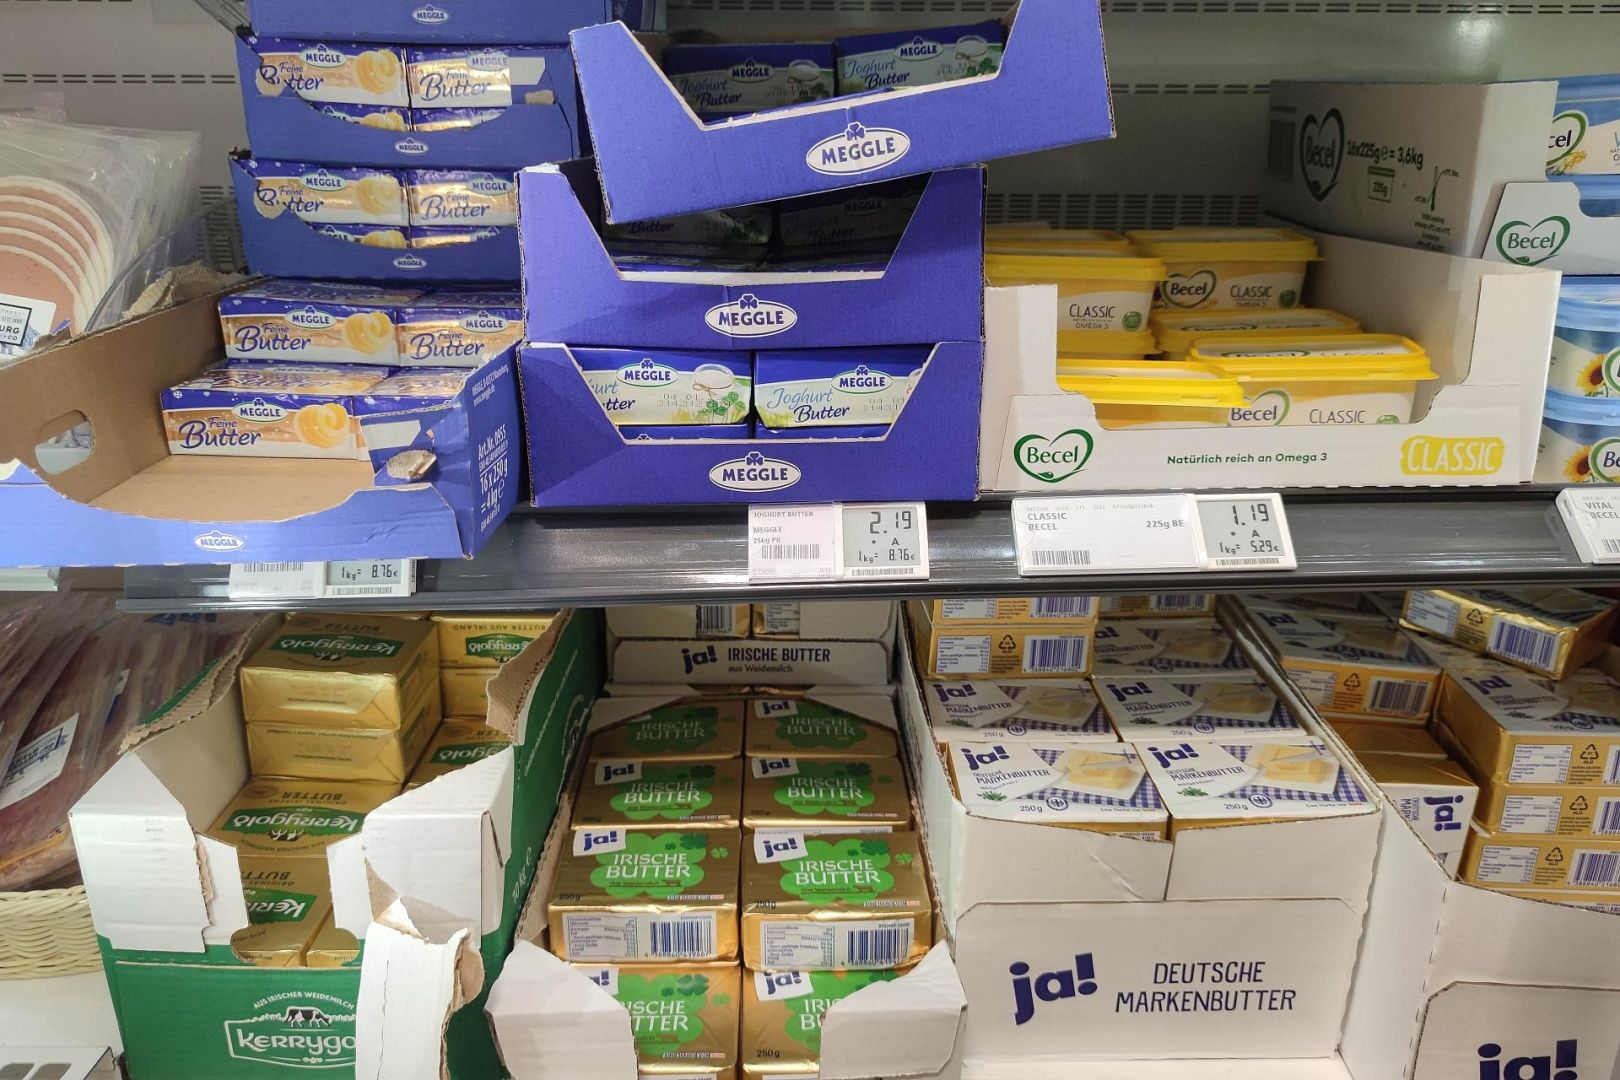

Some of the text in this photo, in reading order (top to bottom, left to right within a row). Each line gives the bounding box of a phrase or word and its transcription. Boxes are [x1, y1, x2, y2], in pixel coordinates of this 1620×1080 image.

[415, 10, 446, 20] MEGGLE
[305, 53, 341, 63] MEGGLE
[900, 45, 937, 56] MEGGLE
[279, 61, 303, 73] Feine
[471, 56, 508, 66] MEGGLE
[843, 57, 896, 79] Joghurt
[732, 68, 770, 78] MEGGLE
[864, 71, 911, 88] Butter
[419, 72, 491, 101] Butter
[697, 93, 742, 108] Butter
[821, 136, 896, 165] MEGGLE
[306, 177, 341, 187] MEGGLE
[472, 182, 508, 191] MEGGLE
[279, 185, 303, 196] Feine
[256, 187, 324, 213] Btter
[420, 194, 490, 220] Butter
[1507, 231, 1555, 249] Becel
[1170, 281, 1207, 296] Becel
[1230, 285, 1273, 297] CLASSIC
[1069, 303, 1115, 318] CLASSIC
[292, 314, 330, 324] MEGGLE
[465, 319, 504, 328] MEGGLE
[717, 310, 785, 327] MEGGLE
[262, 322, 289, 334] Feine
[235, 325, 311, 352] Butter
[410, 333, 485, 360] Butter
[624, 370, 671, 381] MEGGLE
[839, 376, 886, 388] MEGGLE
[766, 387, 833, 411] Joghurt
[240, 407, 281, 417] MEGGLE
[793, 404, 850, 423] Butter
[1231, 405, 1277, 421] Becel
[1310, 408, 1366, 424] CLASSIC
[208, 416, 238, 429] Feine
[178, 420, 262, 449] Butter
[1026, 444, 1079, 465] Becel
[1167, 452, 1328, 464] Natürlich reich an Omega 3
[1407, 440, 1498, 474] CLASSIC
[722, 467, 788, 482] MEGGLE
[870, 510, 911, 534] 2.19
[1027, 512, 1068, 521] CLASSIC
[1232, 504, 1269, 525] 1.19
[1028, 519, 1184, 531] BECEL 225g BE
[1252, 529, 1260, 537] A
[200, 538, 239, 547] MEGGLE
[892, 537, 900, 546] A
[681, 645, 830, 674] ja! IRISCHE BUTTER
[728, 663, 793, 673] aus Weidemilch
[1106, 682, 1152, 702] ja!
[1462, 674, 1512, 695] ja!
[932, 683, 976, 702] ja!
[762, 700, 790, 715] ja!
[945, 702, 1012, 713] MARKENBUTTER
[1125, 700, 1193, 713] MARKENBUTTER
[791, 717, 850, 726] IRISCHE
[636, 728, 705, 740] BUTTER
[787, 725, 856, 736] BUTTER
[960, 745, 1010, 770] ja!
[1147, 743, 1199, 768] ja!
[603, 763, 635, 782] ja!
[759, 758, 791, 775] ja!
[1170, 766, 1244, 782] MARKENBUTTER
[791, 777, 857, 788] IRISCHE
[976, 769, 1050, 785] MARKENBUTTER
[631, 781, 698, 793] IRISCHE
[787, 787, 864, 799] BUTTER
[282, 791, 343, 800] BUTTER
[624, 790, 701, 804] BUTTER
[1423, 795, 1464, 832] ja!
[583, 830, 618, 851] ja!
[763, 837, 798, 858] ja!
[614, 852, 688, 865] IRISCHE
[800, 859, 873, 872] IRISCHE
[606, 863, 691, 879] BUTTER
[795, 871, 881, 885] BUTTER
[763, 971, 803, 995] ja!
[1008, 952, 1266, 1025] ja! DEUTSCHE
[253, 991, 355, 1010] AUS IRISCHER WEIDEMILCH
[1115, 989, 1297, 1013] MARKENBUTTER
[237, 1028, 356, 1055] Kerrygo
